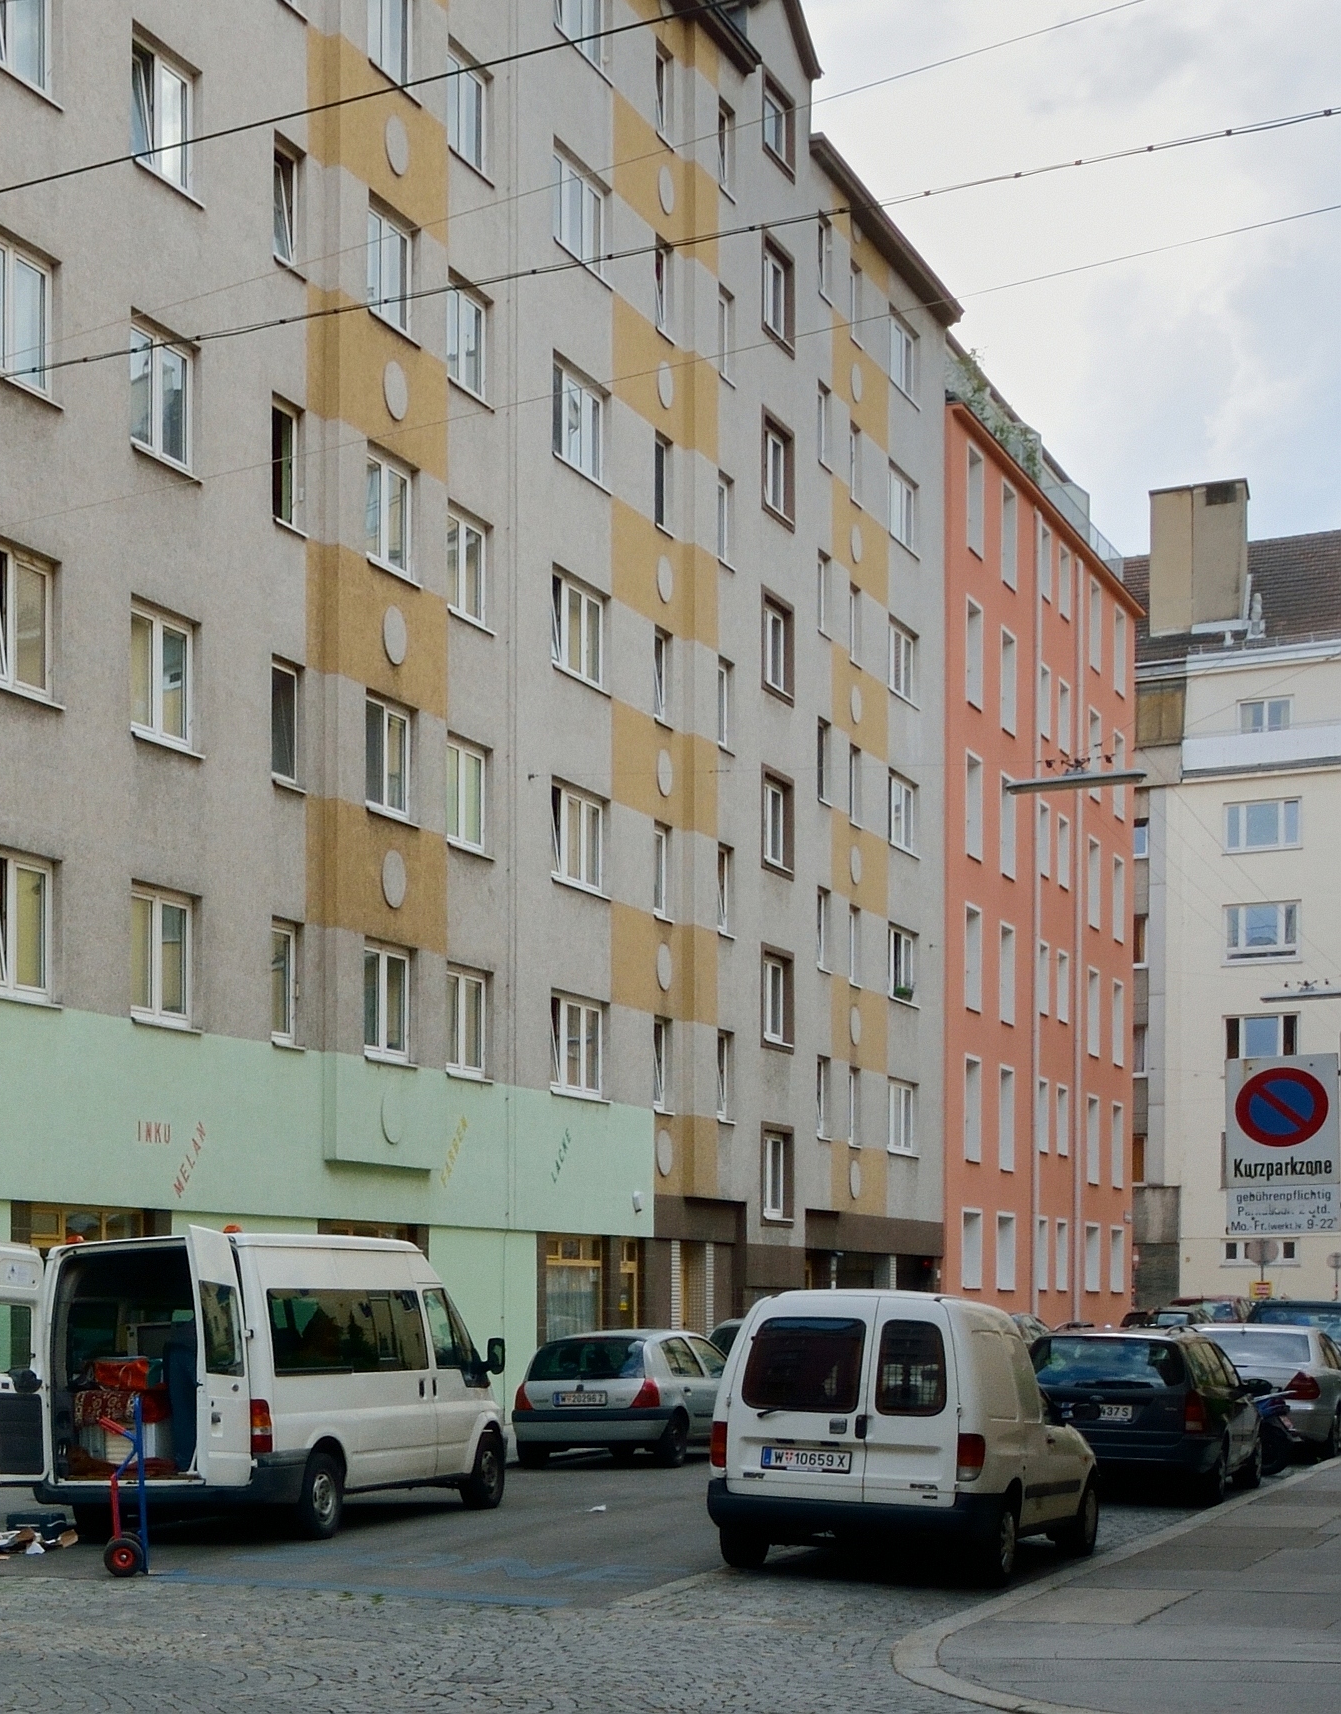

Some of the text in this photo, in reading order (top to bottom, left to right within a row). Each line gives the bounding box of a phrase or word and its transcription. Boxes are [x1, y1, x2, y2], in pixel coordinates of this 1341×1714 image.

[138, 1121, 171, 1144] INKU
[173, 1121, 206, 1199] MELAN
[1233, 1156, 1332, 1181] Kurzparkzone
[1236, 1189, 1331, 1205] gebührenpflichtig
[774, 1451, 783, 1464] W
[795, 1451, 834, 1467] 10659
